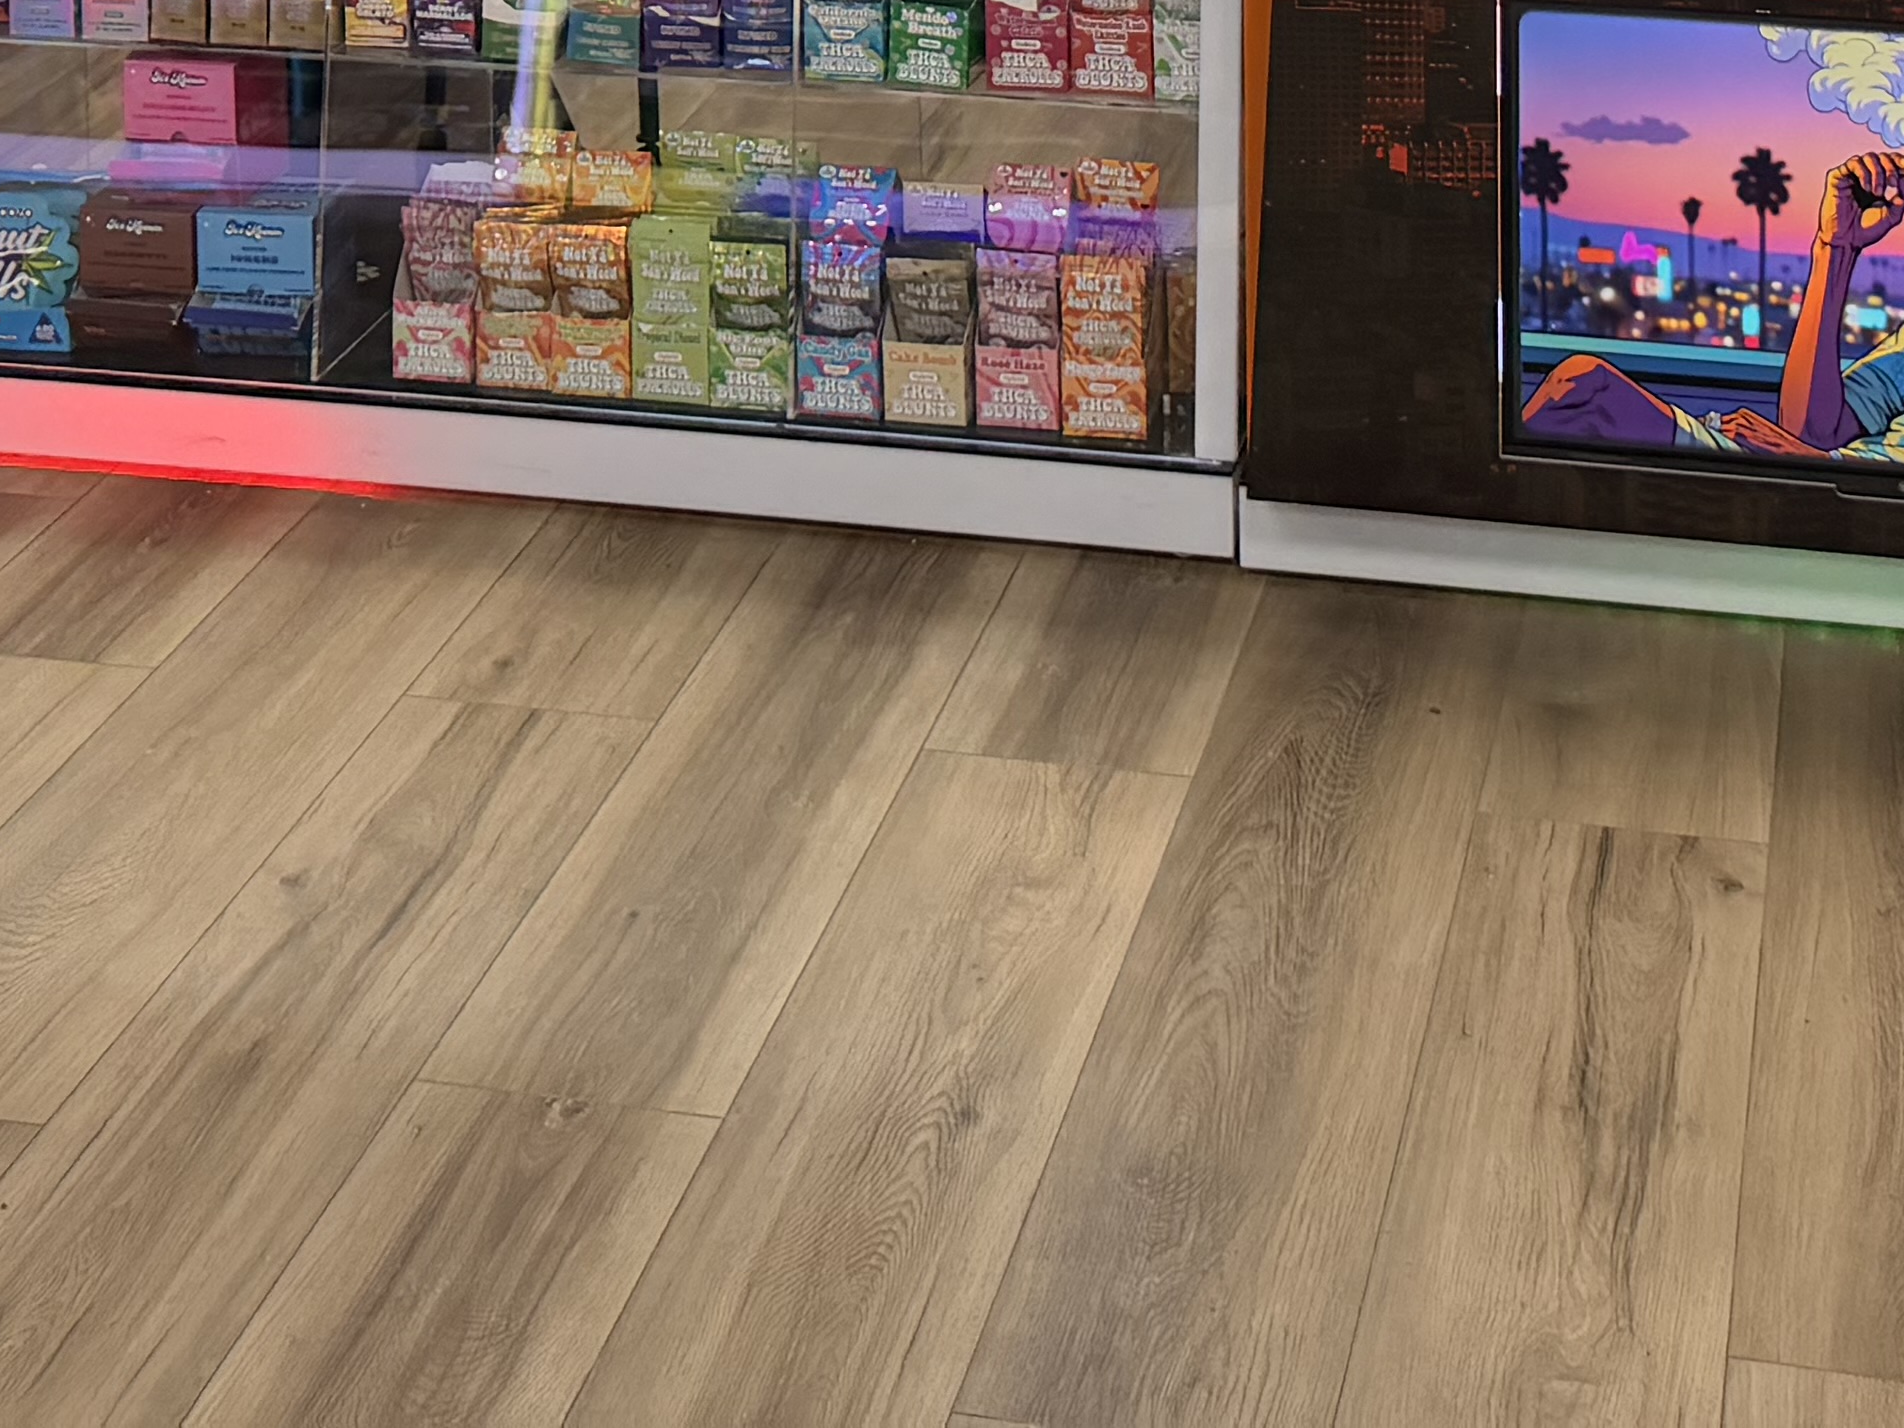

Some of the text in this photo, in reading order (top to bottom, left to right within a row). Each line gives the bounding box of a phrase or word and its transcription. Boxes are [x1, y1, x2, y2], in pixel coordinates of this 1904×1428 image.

[902, 9, 949, 25] Mendo
[908, 23, 958, 39] Breath
[803, 391, 872, 412] BLUNTS
[893, 400, 957, 419] BLUNTS
[982, 403, 1048, 421] BLUNTS
